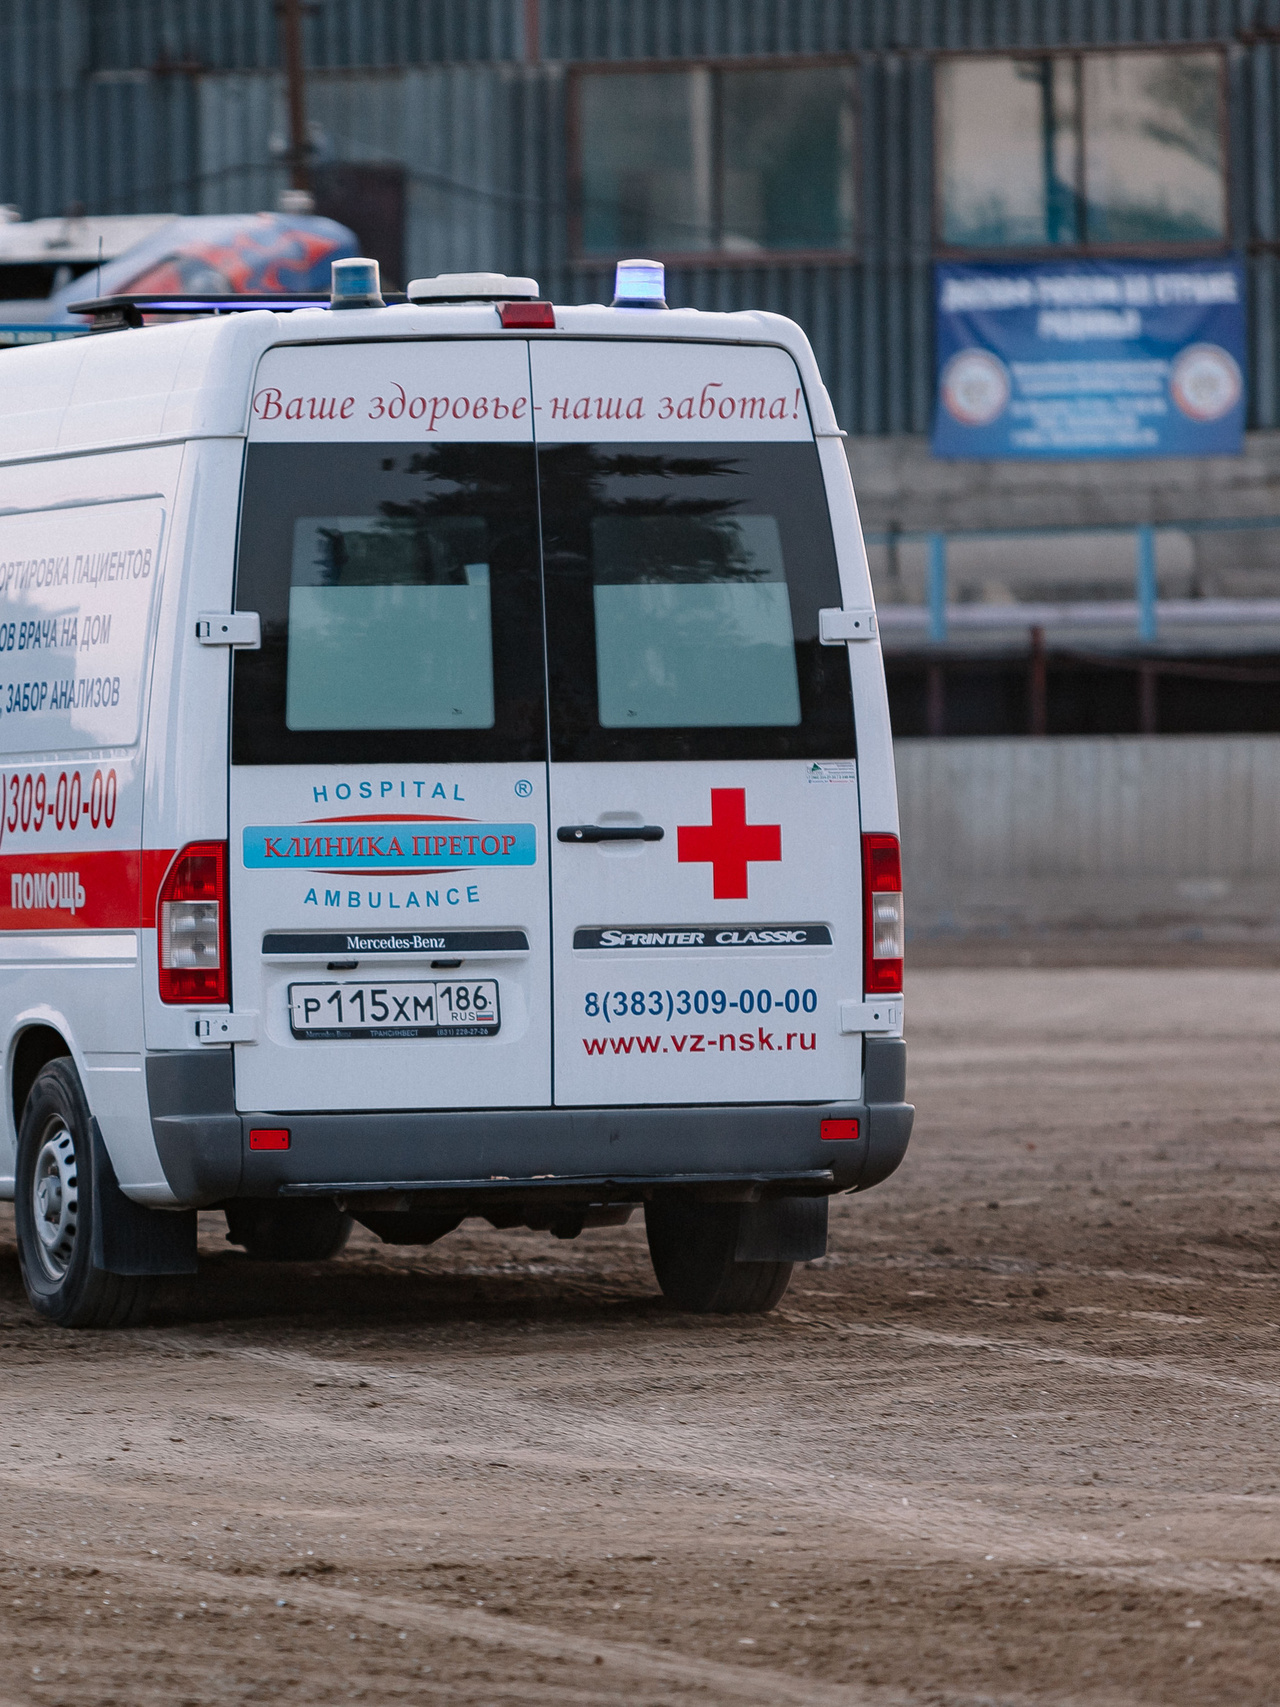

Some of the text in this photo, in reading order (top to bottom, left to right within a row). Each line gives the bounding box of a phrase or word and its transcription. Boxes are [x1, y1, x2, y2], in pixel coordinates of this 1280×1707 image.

[253, 387, 355, 420] Ваше
[368, 381, 527, 432] здоровье
[549, 396, 648, 420] наша
[657, 382, 801, 420] забота!
[72, 548, 152, 588] ПАЦИЕНТОВ
[18, 619, 58, 650] ВРАЧА
[61, 617, 78, 647] НА
[80, 614, 112, 652] ДОМ
[6, 681, 48, 713] ЗАБОР
[49, 676, 120, 710] АНАЛИЗОВ
[312, 780, 466, 803] HOSPITAL
[263, 835, 517, 858] КЛИНИКА ПРЕТОР
[11, 871, 86, 915] ПОМОЩЬ
[303, 885, 480, 909] AMBULANCE
[346, 935, 446, 950] Mercedes-Benz
[439, 985, 488, 1011] 186
[584, 988, 818, 1023] 8(383)309-00-00
[451, 1011, 476, 1022] RUS
[582, 1026, 817, 1056] www.vz-nsk.ru
